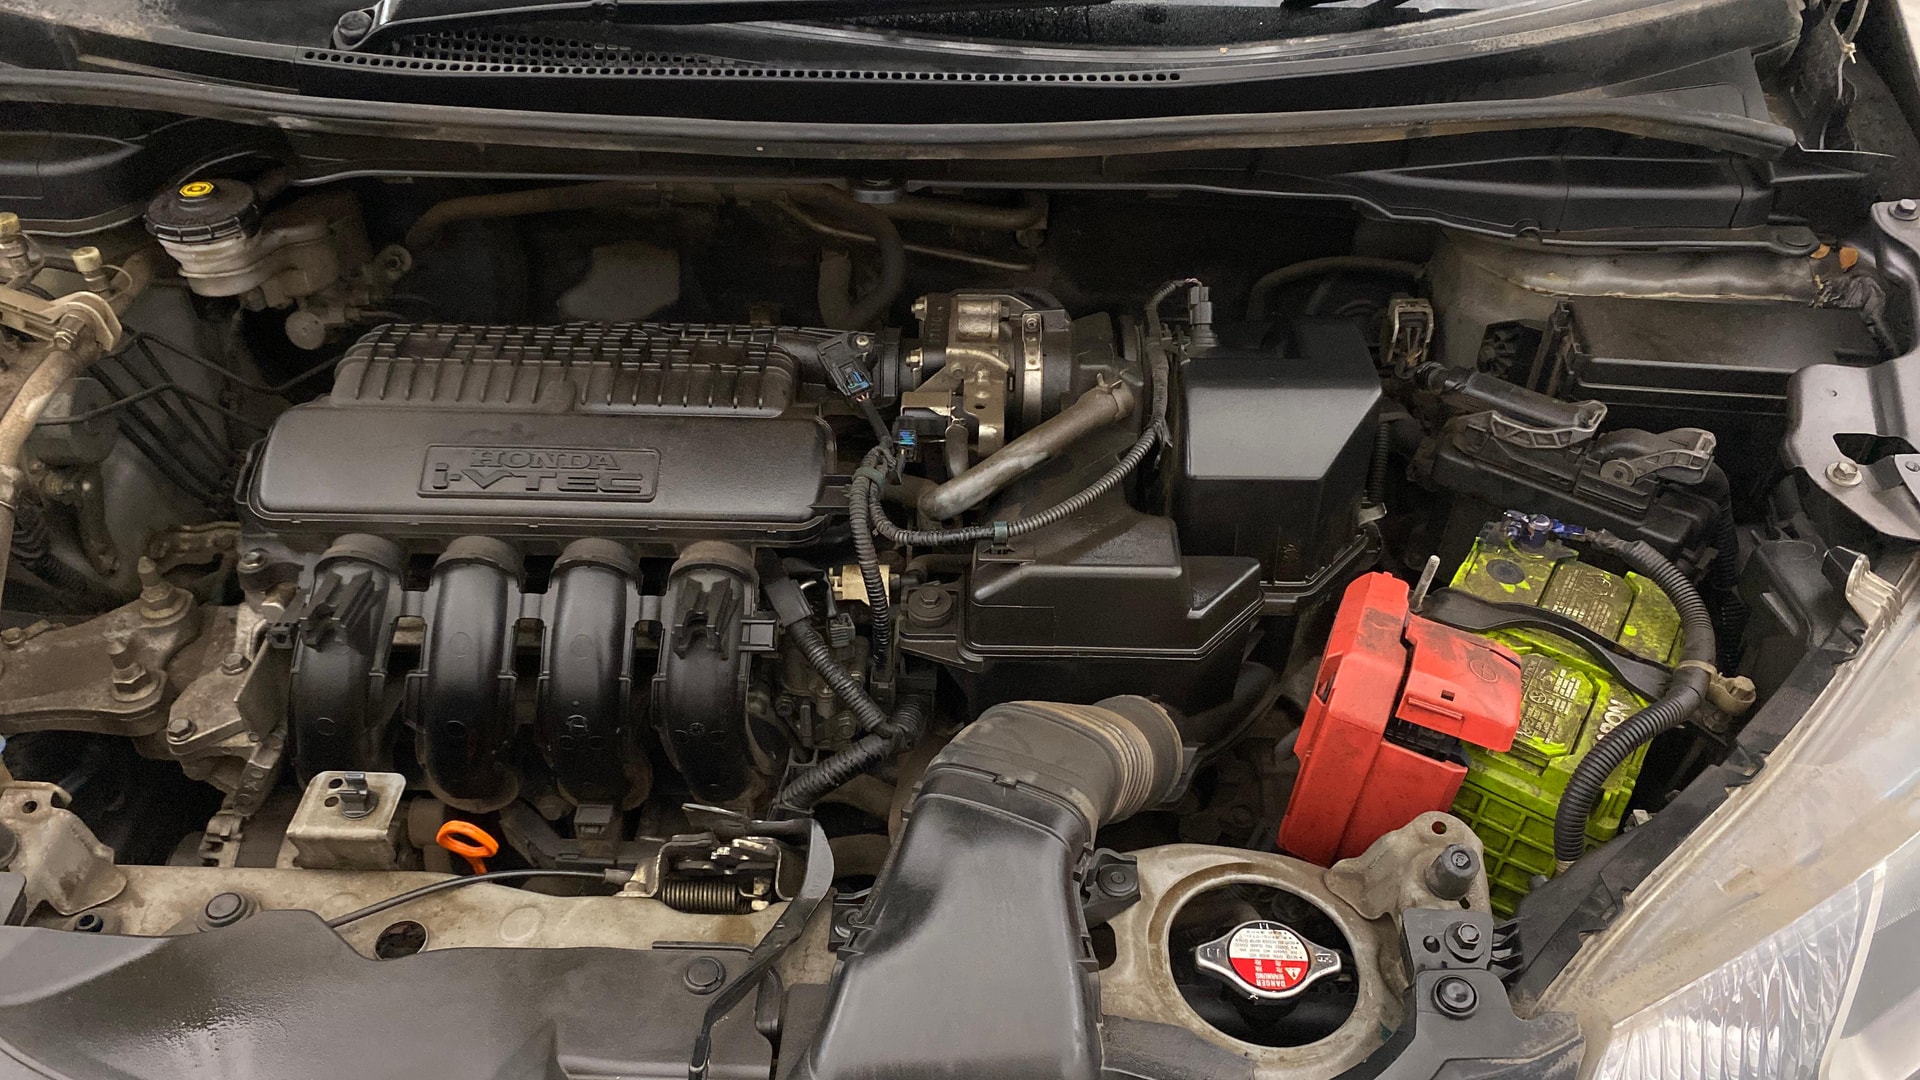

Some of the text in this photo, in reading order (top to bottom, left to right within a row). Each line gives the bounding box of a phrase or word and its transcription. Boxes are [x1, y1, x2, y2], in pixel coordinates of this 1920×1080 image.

[470, 450, 620, 471] HONDA
[433, 462, 642, 494] i-VTEC
[1255, 979, 1286, 988] DANGER
